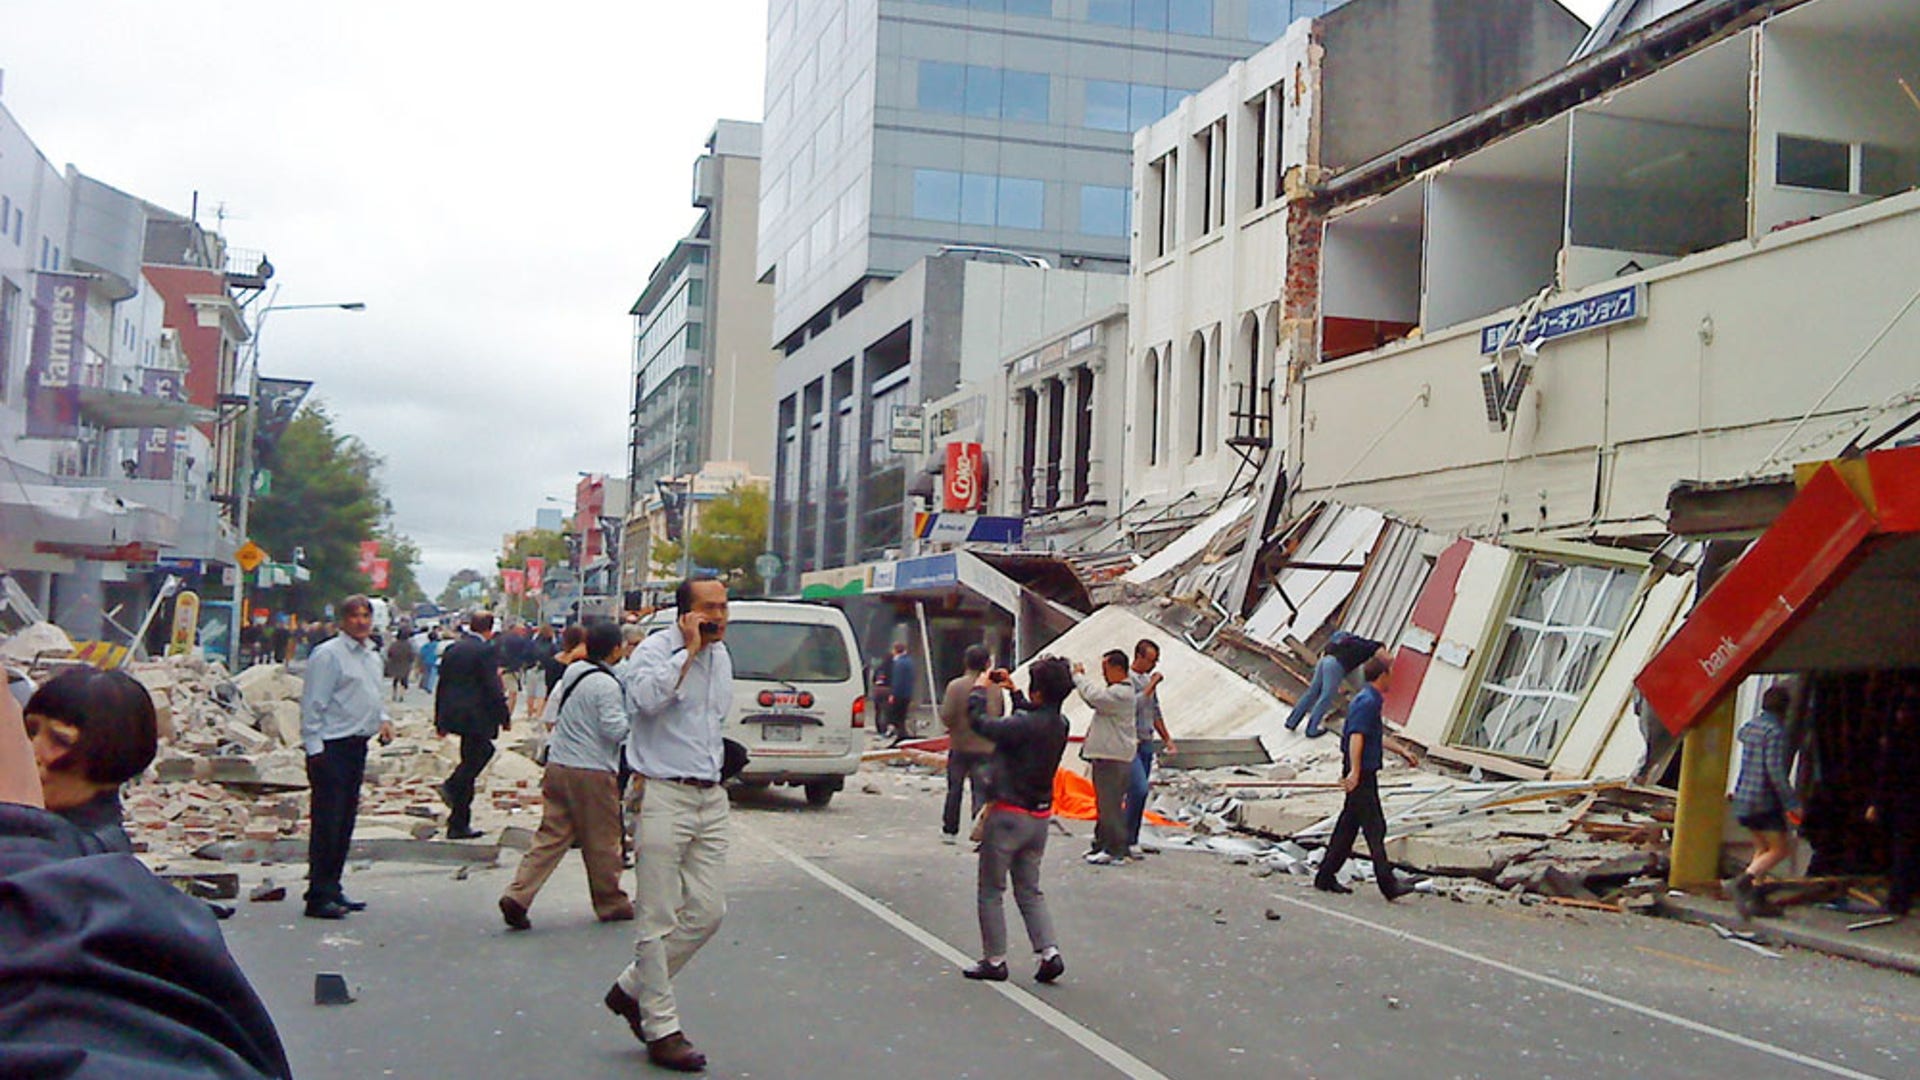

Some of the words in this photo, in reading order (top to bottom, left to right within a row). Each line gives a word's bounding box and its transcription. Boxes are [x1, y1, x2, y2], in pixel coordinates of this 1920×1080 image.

[39, 286, 75, 387] Farmers
[952, 454, 971, 499] Coke
[1698, 636, 1739, 677] bank
